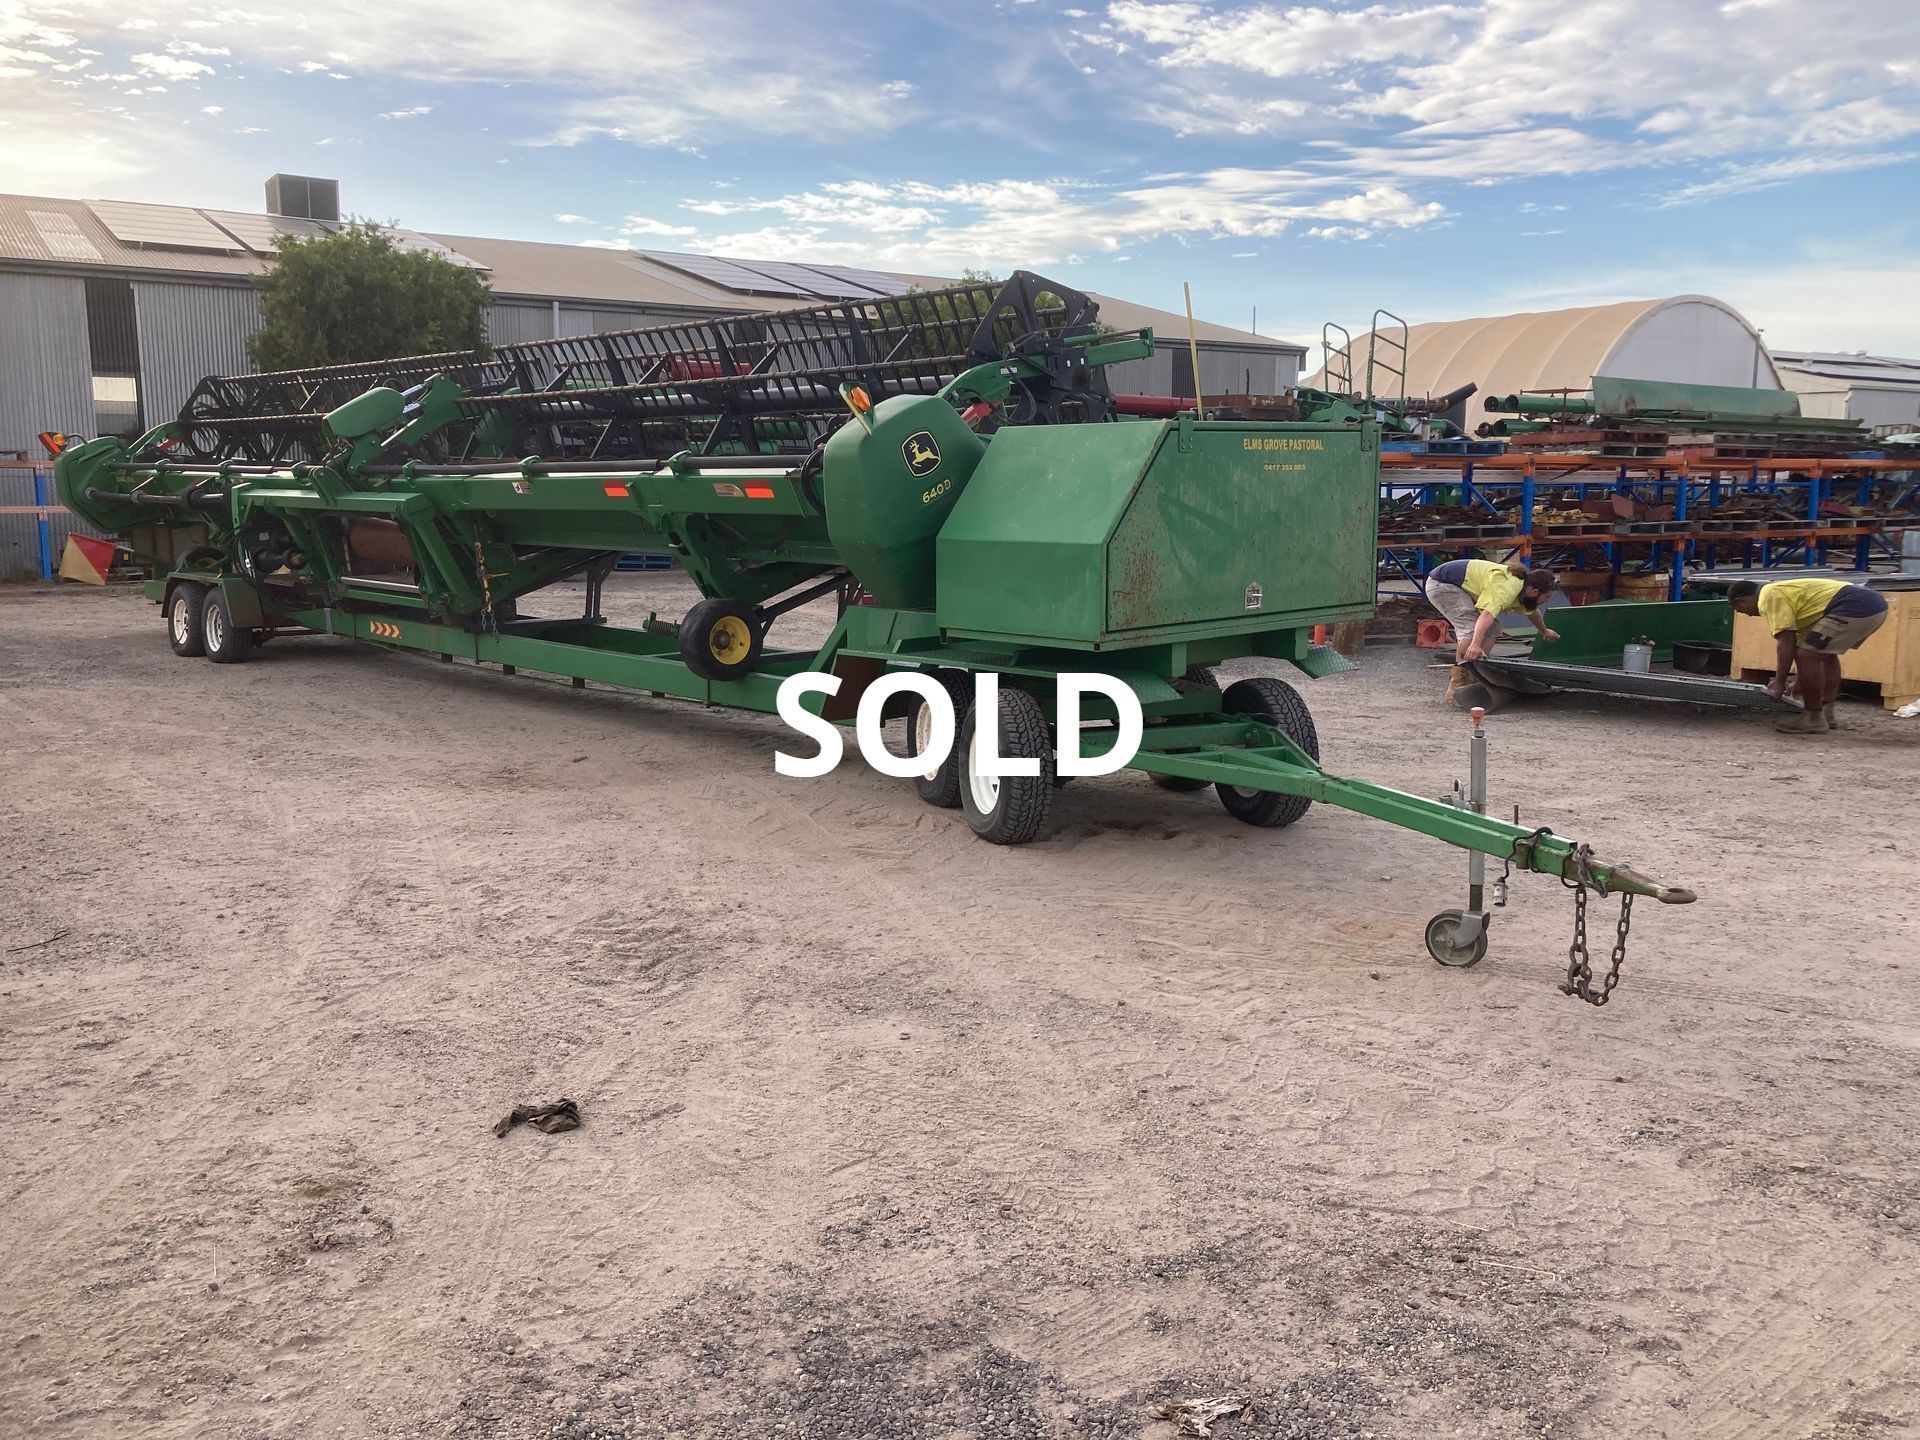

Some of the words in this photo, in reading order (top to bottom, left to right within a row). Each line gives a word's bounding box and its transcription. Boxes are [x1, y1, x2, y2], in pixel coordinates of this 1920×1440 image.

[1243, 438, 1262, 450] ELMS
[1264, 439, 1288, 450] GROVE
[1289, 439, 1323, 450] PASTORAL
[922, 479, 951, 503] 640D
